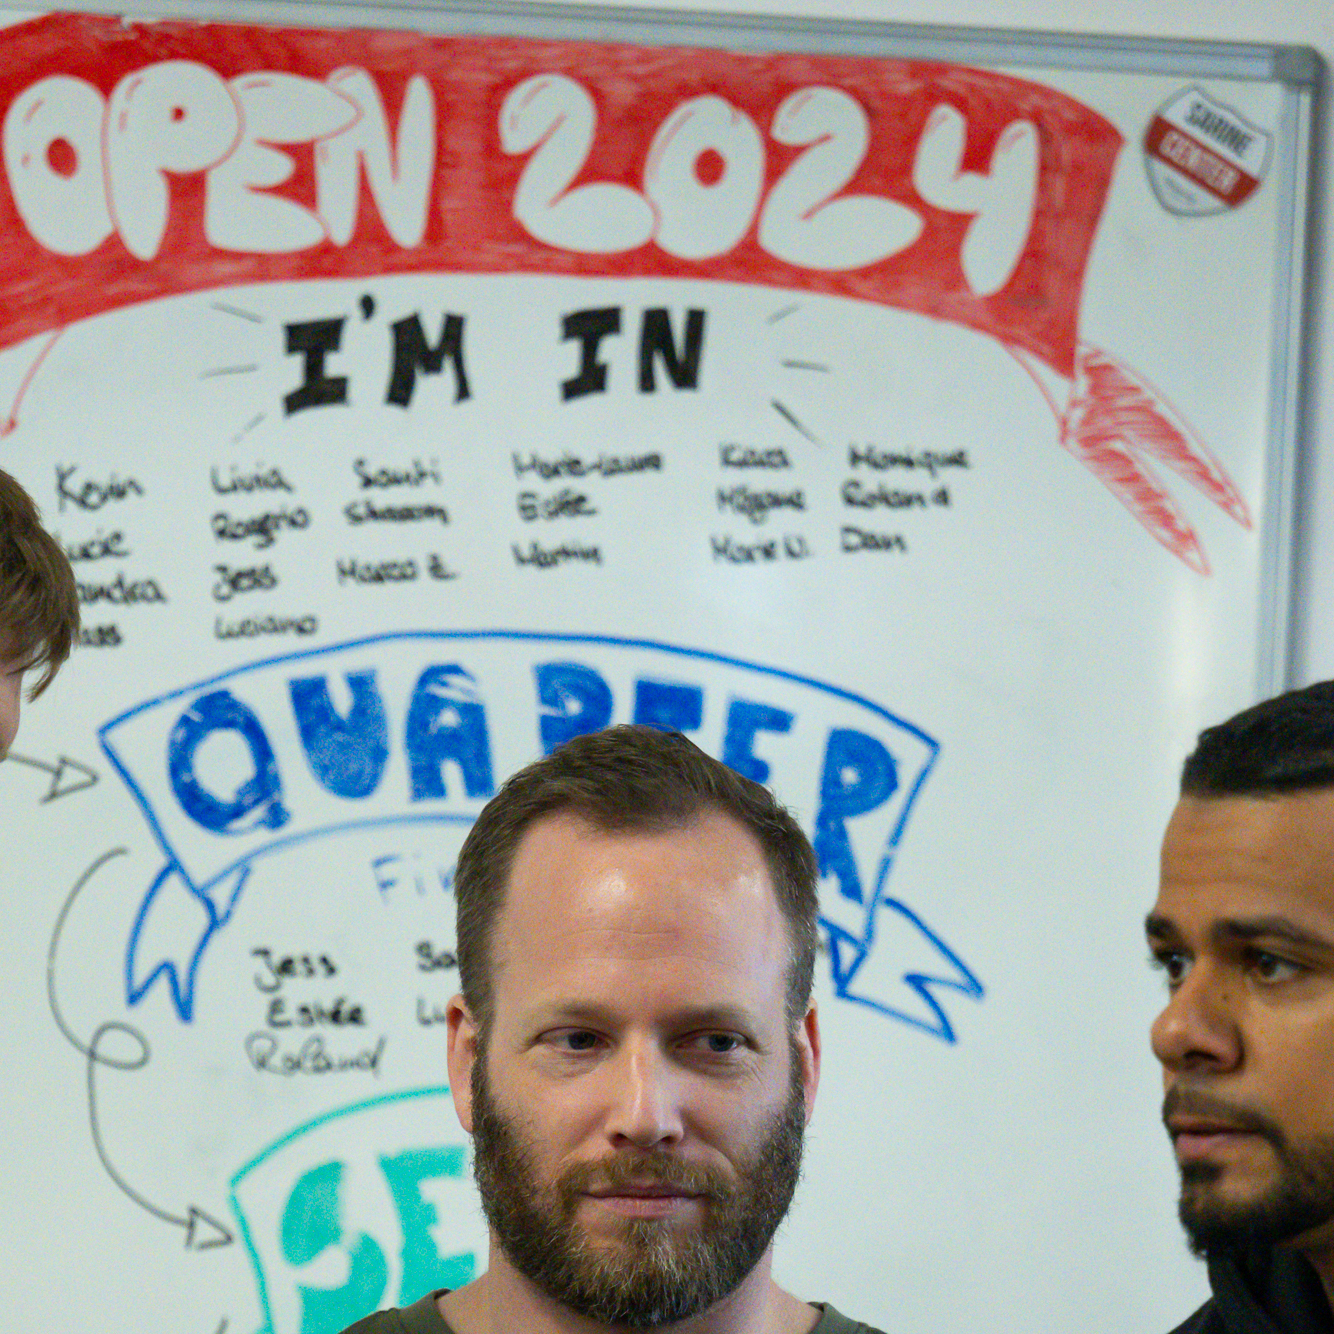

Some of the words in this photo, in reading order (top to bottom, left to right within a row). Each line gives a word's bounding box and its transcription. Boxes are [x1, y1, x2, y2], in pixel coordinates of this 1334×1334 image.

[3, 59, 436, 261] OPEN
[499, 74, 1040, 297] 2024
[284, 294, 471, 415] I'M
[561, 306, 705, 401] IN
[55, 463, 145, 513] Kevin
[210, 460, 295, 496] Livia
[66, 527, 132, 561] ucie
[840, 524, 908, 554] Dan
[75, 570, 168, 607] andra
[212, 562, 279, 602] Jess
[250, 946, 338, 994] Jess
